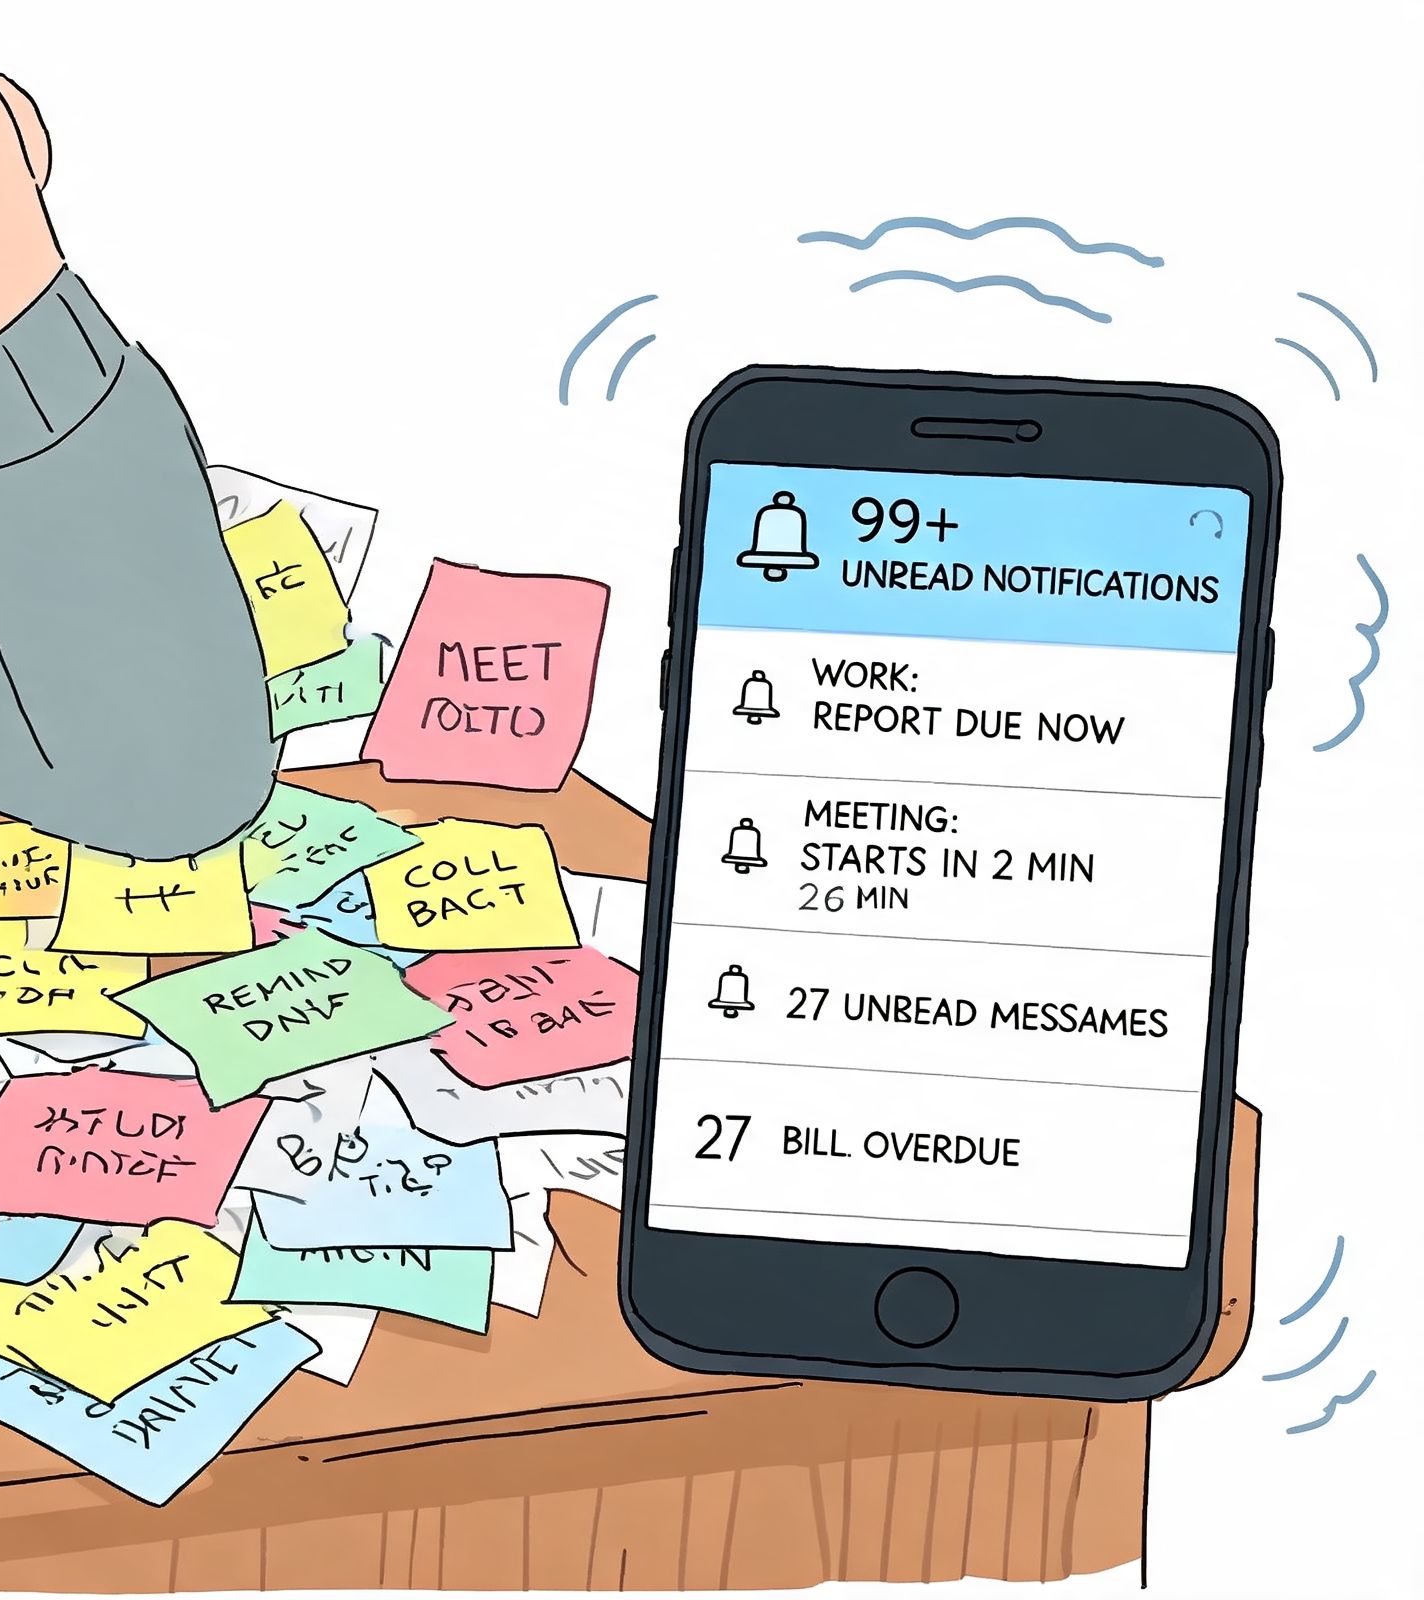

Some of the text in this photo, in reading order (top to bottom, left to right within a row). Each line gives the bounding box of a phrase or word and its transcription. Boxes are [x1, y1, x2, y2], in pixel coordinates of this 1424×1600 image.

[851, 496, 959, 544] 99+
[842, 559, 1220, 604] UNREAD NOTIFICATIONS
[438, 641, 562, 682] MEET
[811, 657, 918, 693] WORK:
[813, 700, 1126, 745] REPORT DUE NOW
[804, 799, 958, 834] MEETING:
[800, 842, 1094, 883] STARTS IN 2 MIN
[798, 882, 908, 913] 26 MIN
[786, 986, 830, 1021] 27
[990, 1001, 1168, 1038] MESSAMES
[694, 1113, 752, 1162] 27
[863, 1130, 1021, 1167] OVERDUE
